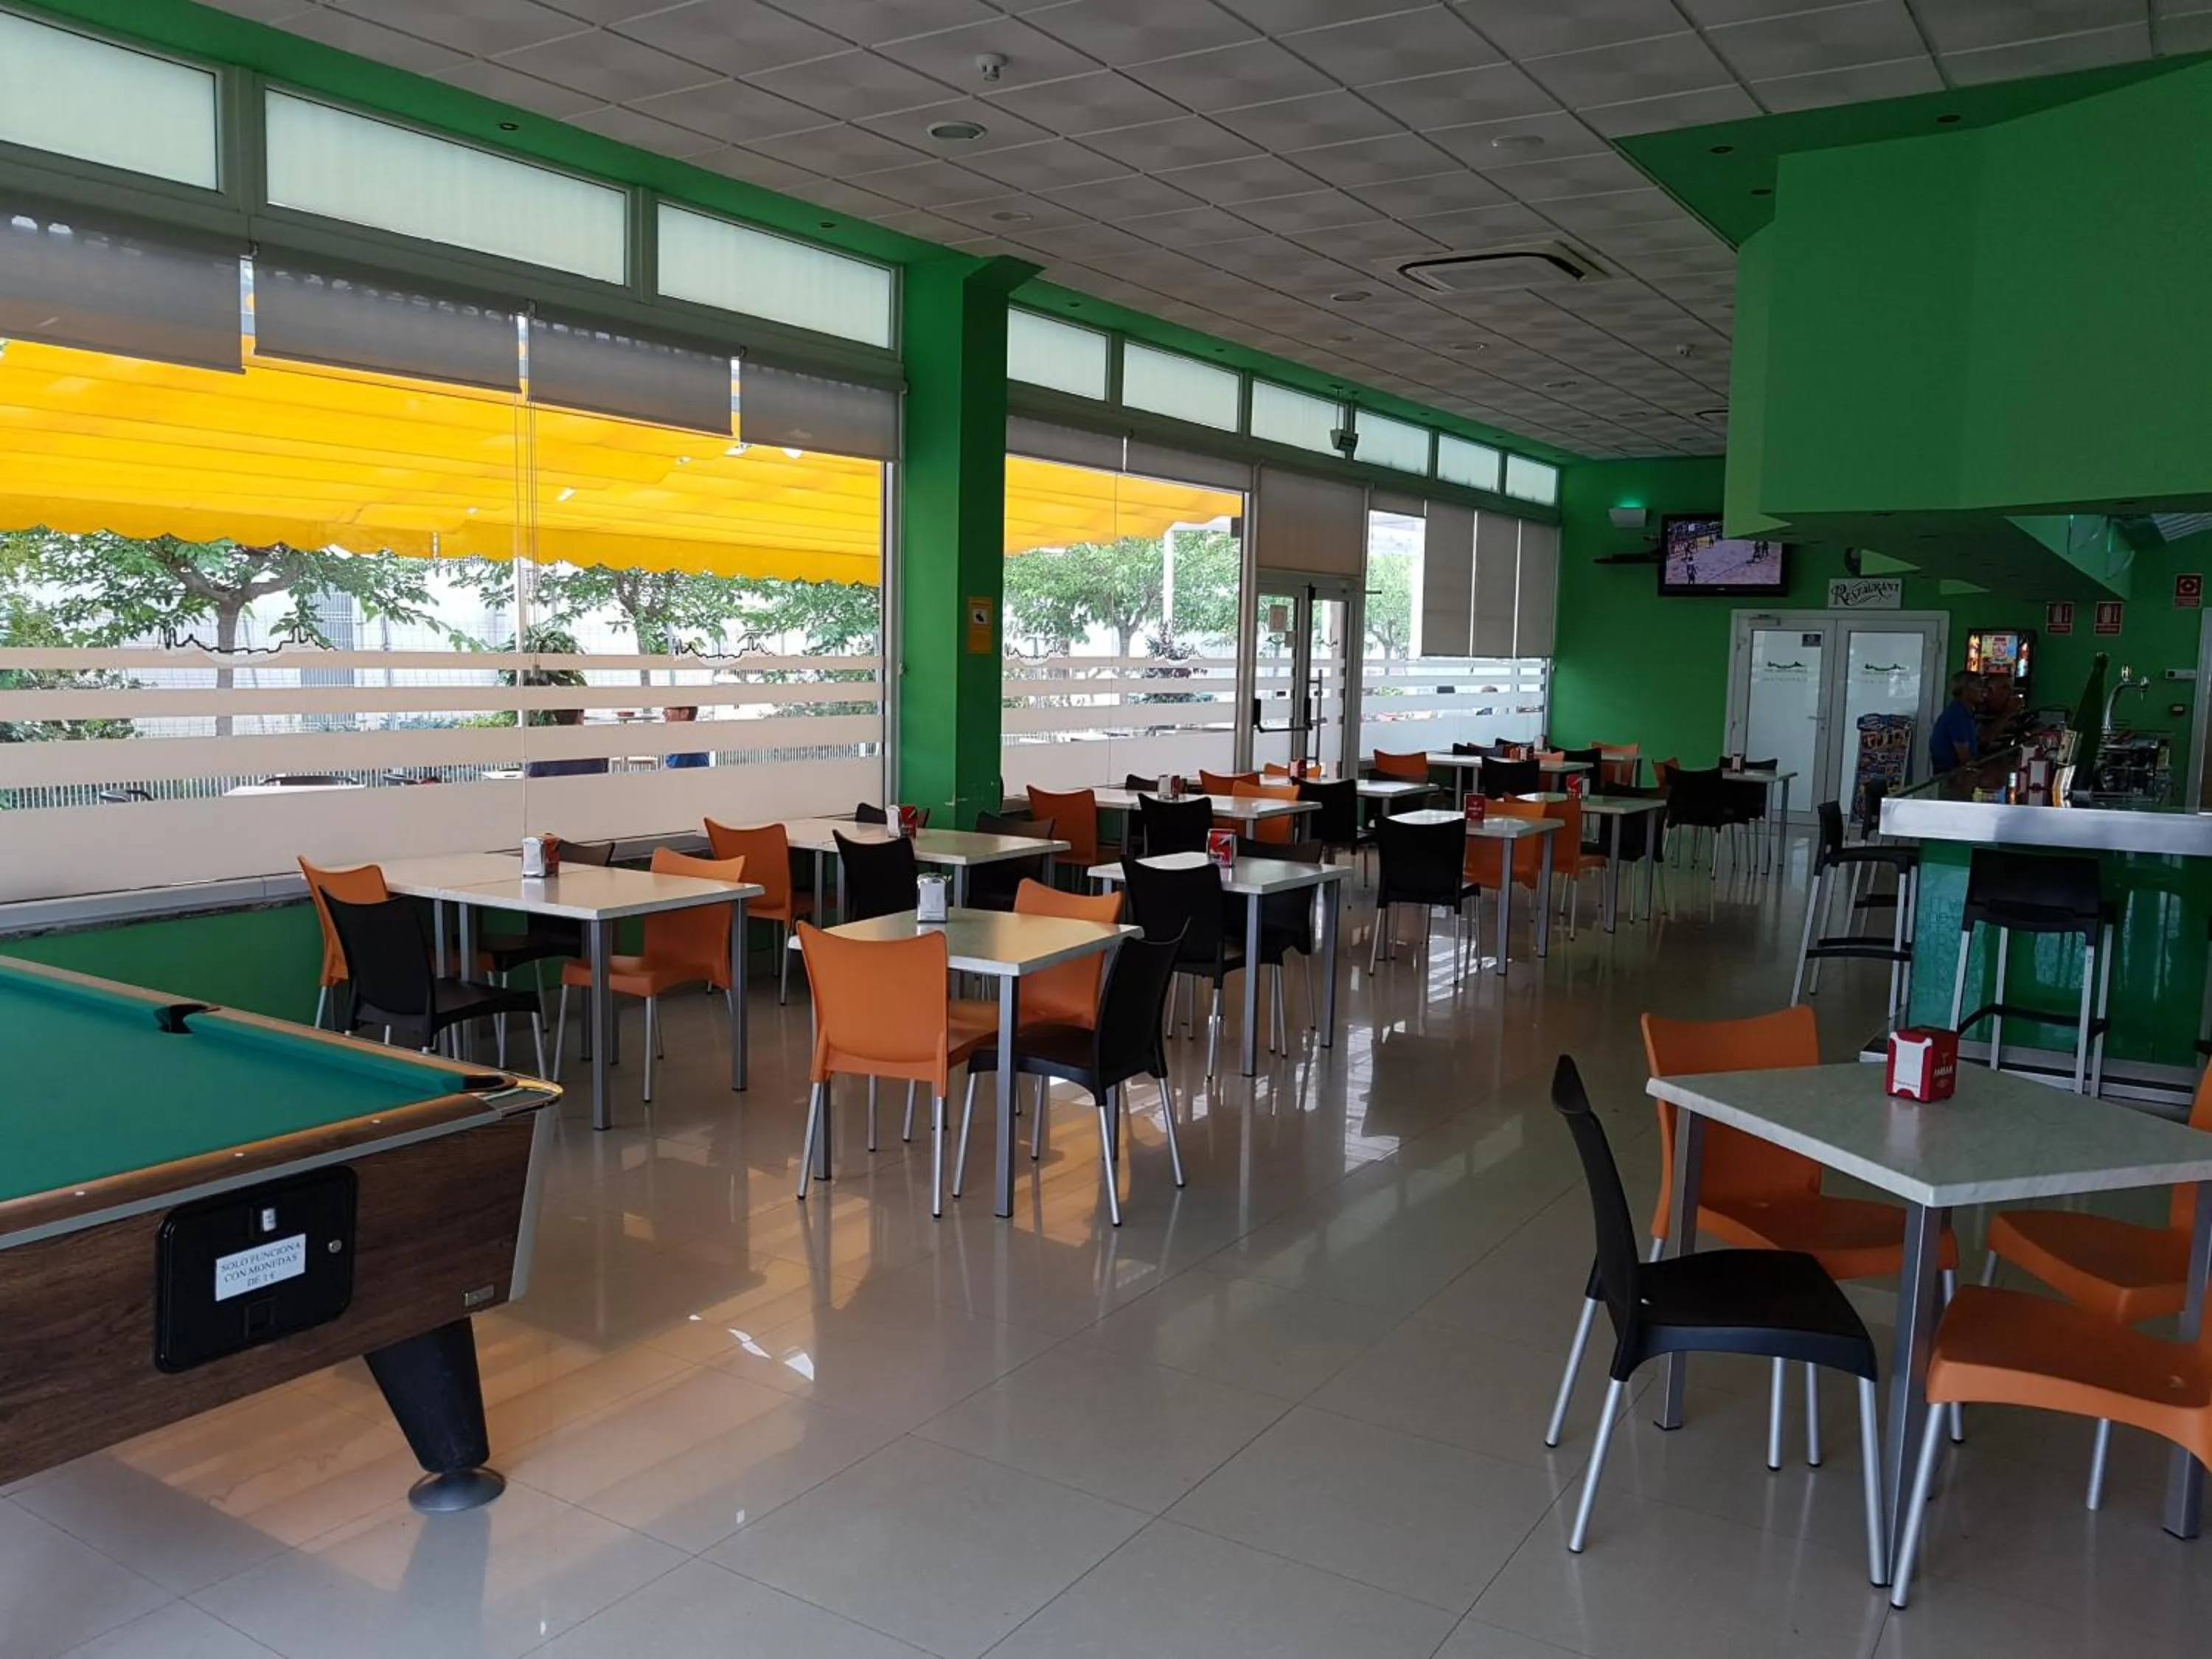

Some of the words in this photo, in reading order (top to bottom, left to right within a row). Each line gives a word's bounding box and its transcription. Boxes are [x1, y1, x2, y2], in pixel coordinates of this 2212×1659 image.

[221, 1256, 248, 1271] SOLO
[251, 1242, 301, 1261] FUNCIONA
[224, 1269, 247, 1284] CON
[249, 1254, 297, 1275] MONEDAS
[247, 1276, 260, 1287] DE
